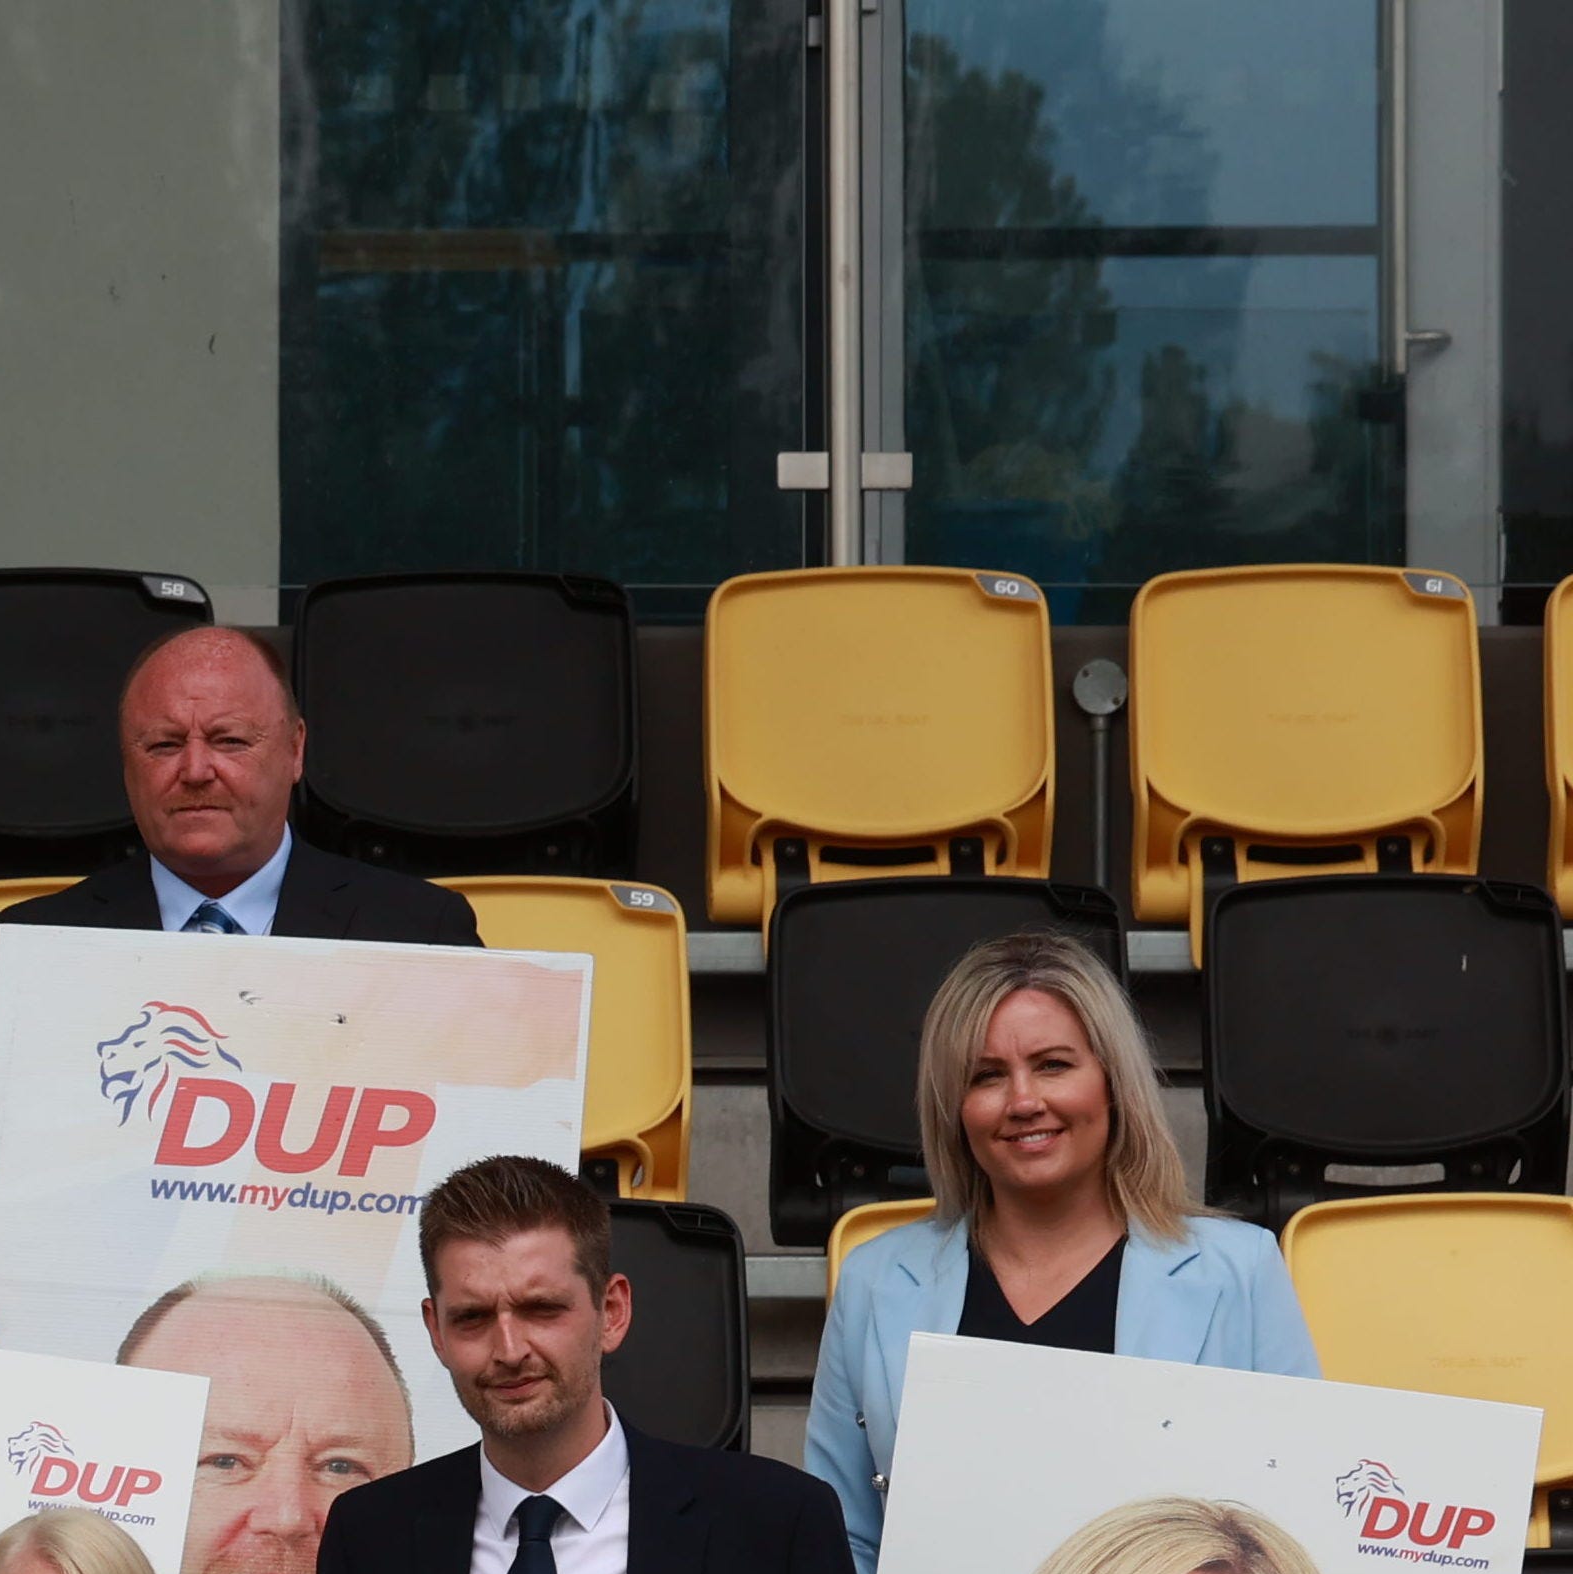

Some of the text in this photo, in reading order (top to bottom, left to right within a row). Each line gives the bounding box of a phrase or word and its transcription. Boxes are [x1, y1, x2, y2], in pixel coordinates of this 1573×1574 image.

[161, 582, 184, 596] 58
[994, 581, 1019, 595] 60
[1426, 580, 1442, 594] 61
[630, 892, 654, 906] 59
[153, 1076, 437, 1178] DUP
[150, 1178, 430, 1216] www.mydup.com
[31, 1456, 162, 1507] DUP
[1360, 1496, 1496, 1550] DUP
[1357, 1542, 1490, 1570] www.mydup.com
